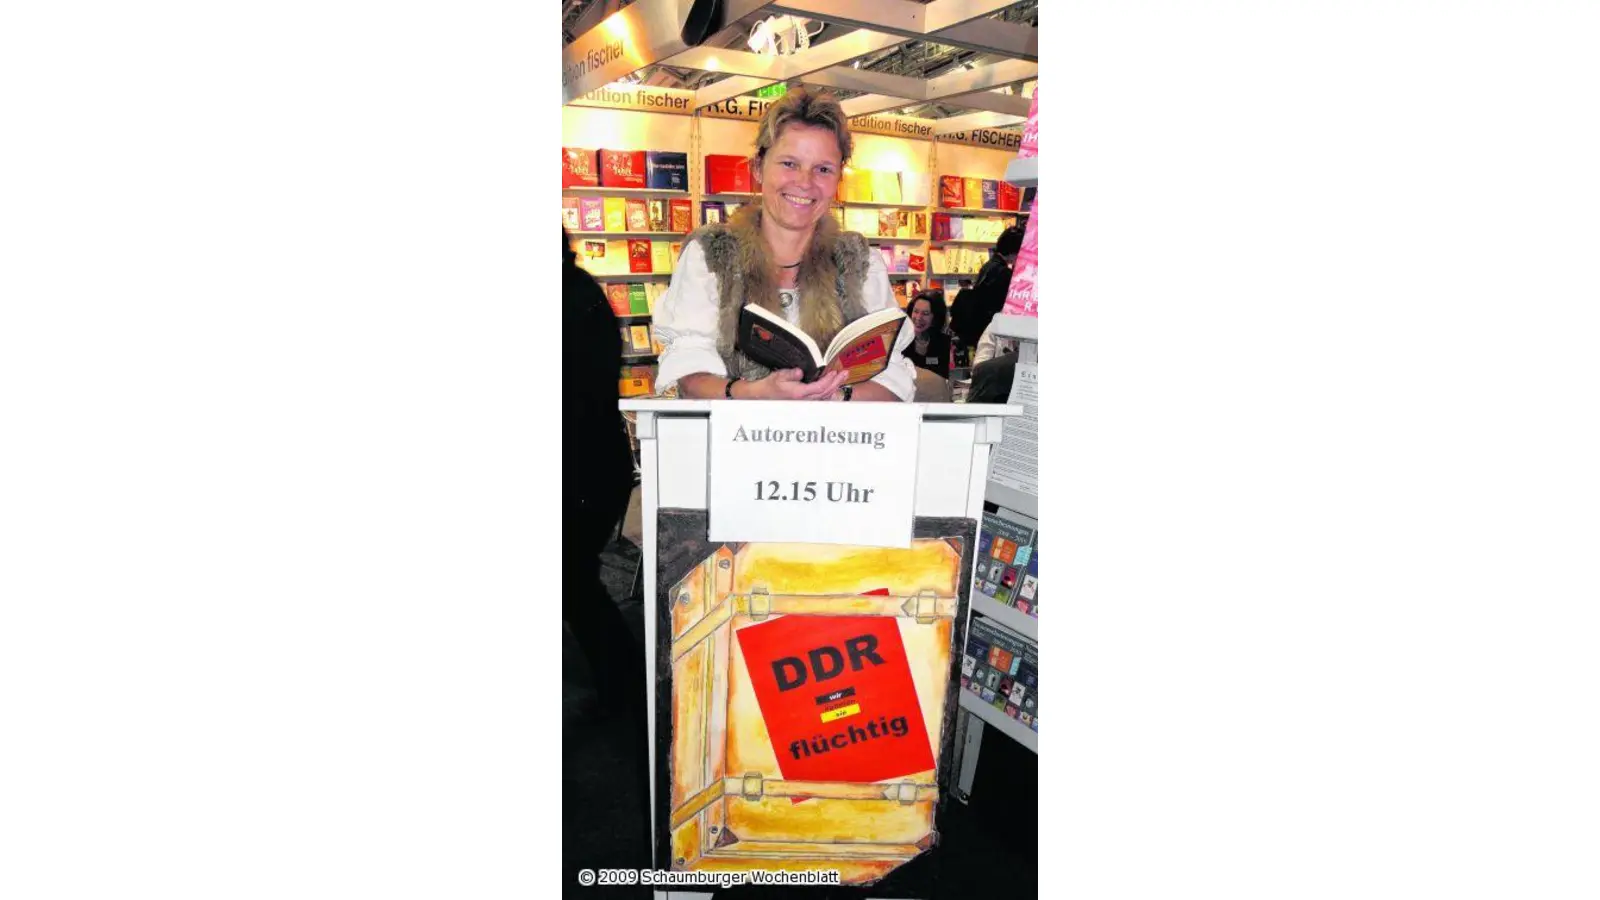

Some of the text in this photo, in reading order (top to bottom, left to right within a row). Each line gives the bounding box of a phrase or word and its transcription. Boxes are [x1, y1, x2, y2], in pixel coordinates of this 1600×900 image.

[638, 91, 691, 110] fischer
[851, 116, 932, 136] edition fischer
[971, 130, 1021, 148] FISCHER
[732, 425, 886, 450] Autorenlesung
[753, 481, 875, 504] 12.15 Uhr
[771, 633, 887, 692] DDR
[828, 692, 843, 701] wir
[788, 716, 909, 761] flüchtig
